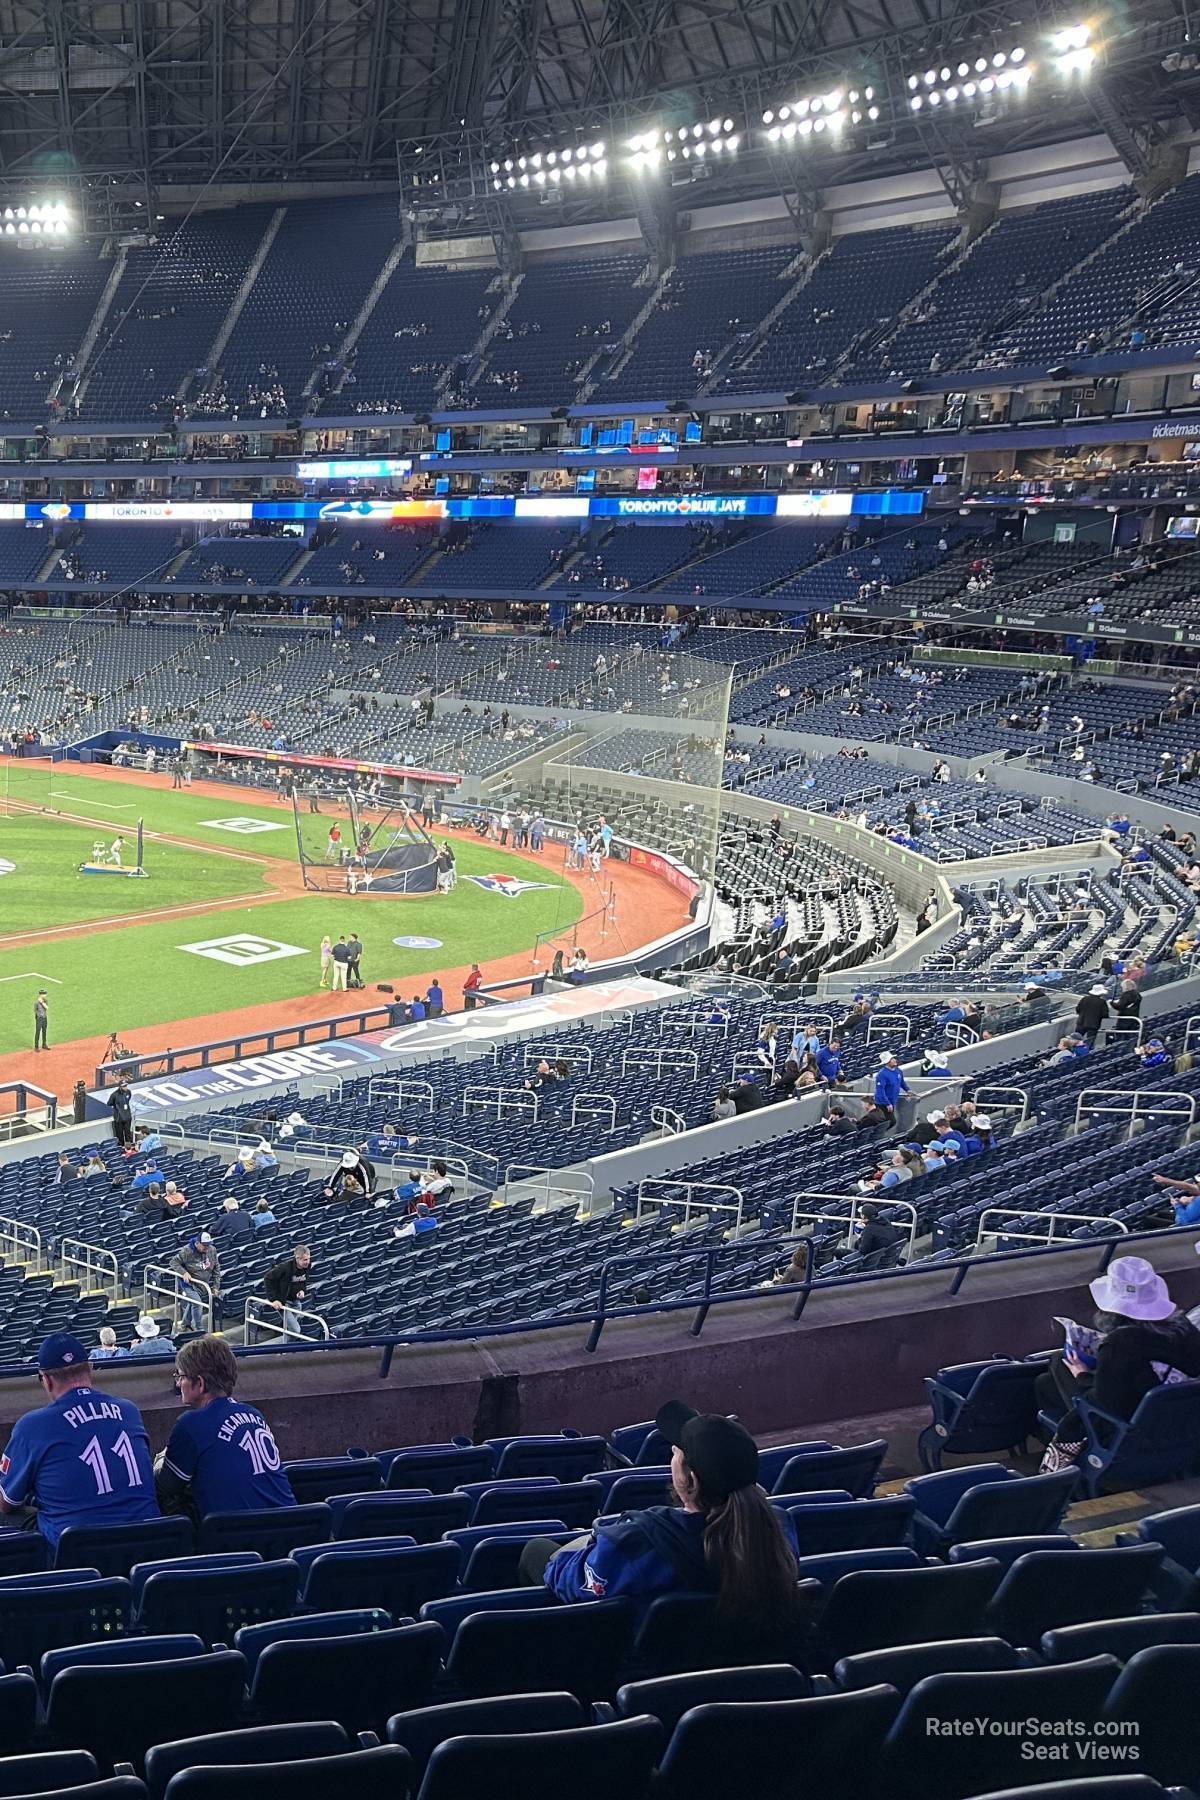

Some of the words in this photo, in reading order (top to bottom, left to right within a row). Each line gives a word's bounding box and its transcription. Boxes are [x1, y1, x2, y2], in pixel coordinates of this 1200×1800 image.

[1153, 424, 1200, 437] ticketmas
[112, 506, 162, 516] TORONTO
[619, 500, 677, 512] TORONTO
[691, 501, 716, 512] BLUE
[718, 500, 746, 512] JAYS
[1057, 527, 1075, 542] TD
[211, 1045, 358, 1087] CORE
[134, 1082, 200, 1106] TO
[194, 1080, 243, 1099] THE
[63, 1402, 123, 1429] PILLAR
[238, 1428, 280, 1475] 10
[79, 1430, 143, 1495] 11
